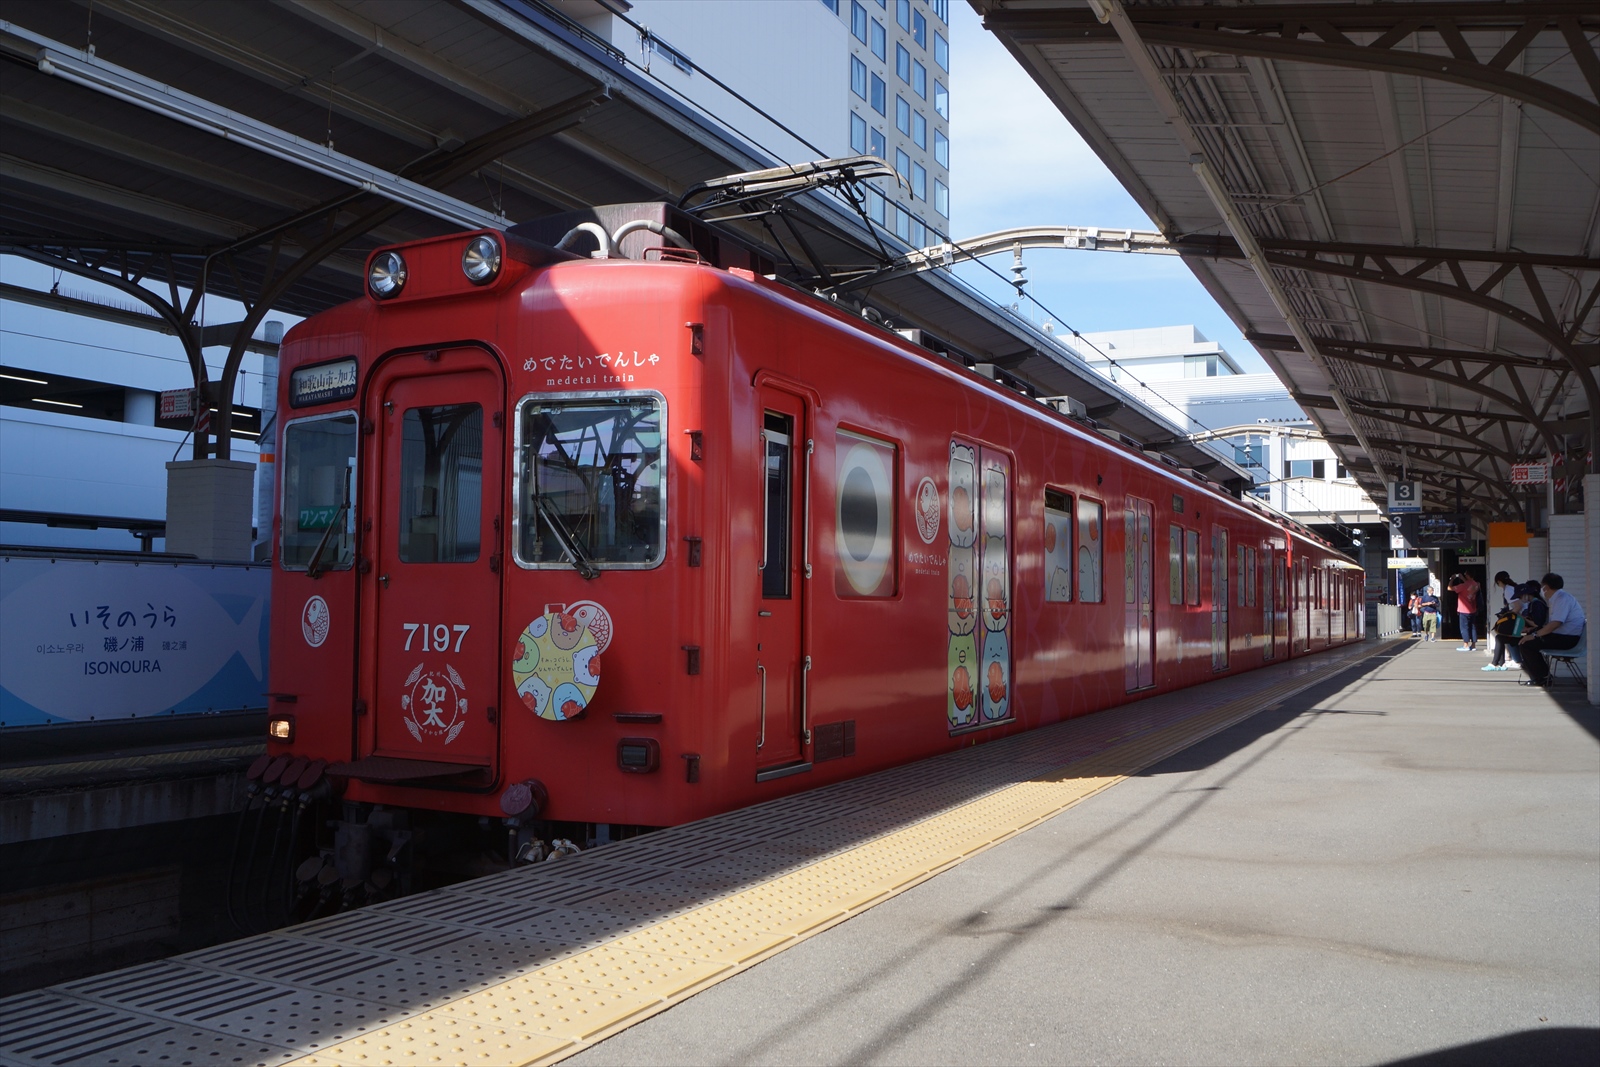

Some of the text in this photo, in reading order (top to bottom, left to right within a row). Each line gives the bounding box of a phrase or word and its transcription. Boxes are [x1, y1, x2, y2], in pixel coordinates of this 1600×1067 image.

[523, 351, 660, 373] めでたいでんしゃ
[547, 373, 635, 386] medetai train
[1399, 485, 1411, 498] 3
[1393, 516, 1402, 528] 3
[908, 552, 946, 565] めでたいでんしゃ
[70, 603, 177, 630] いそのうら
[103, 636, 145, 652] 磯ノ浦
[403, 623, 470, 653] 7197
[36, 643, 85, 655] 이소노우라
[162, 640, 187, 651] 磯之浦
[84, 659, 162, 675] ISONOURA
[420, 677, 447, 728] 加太
